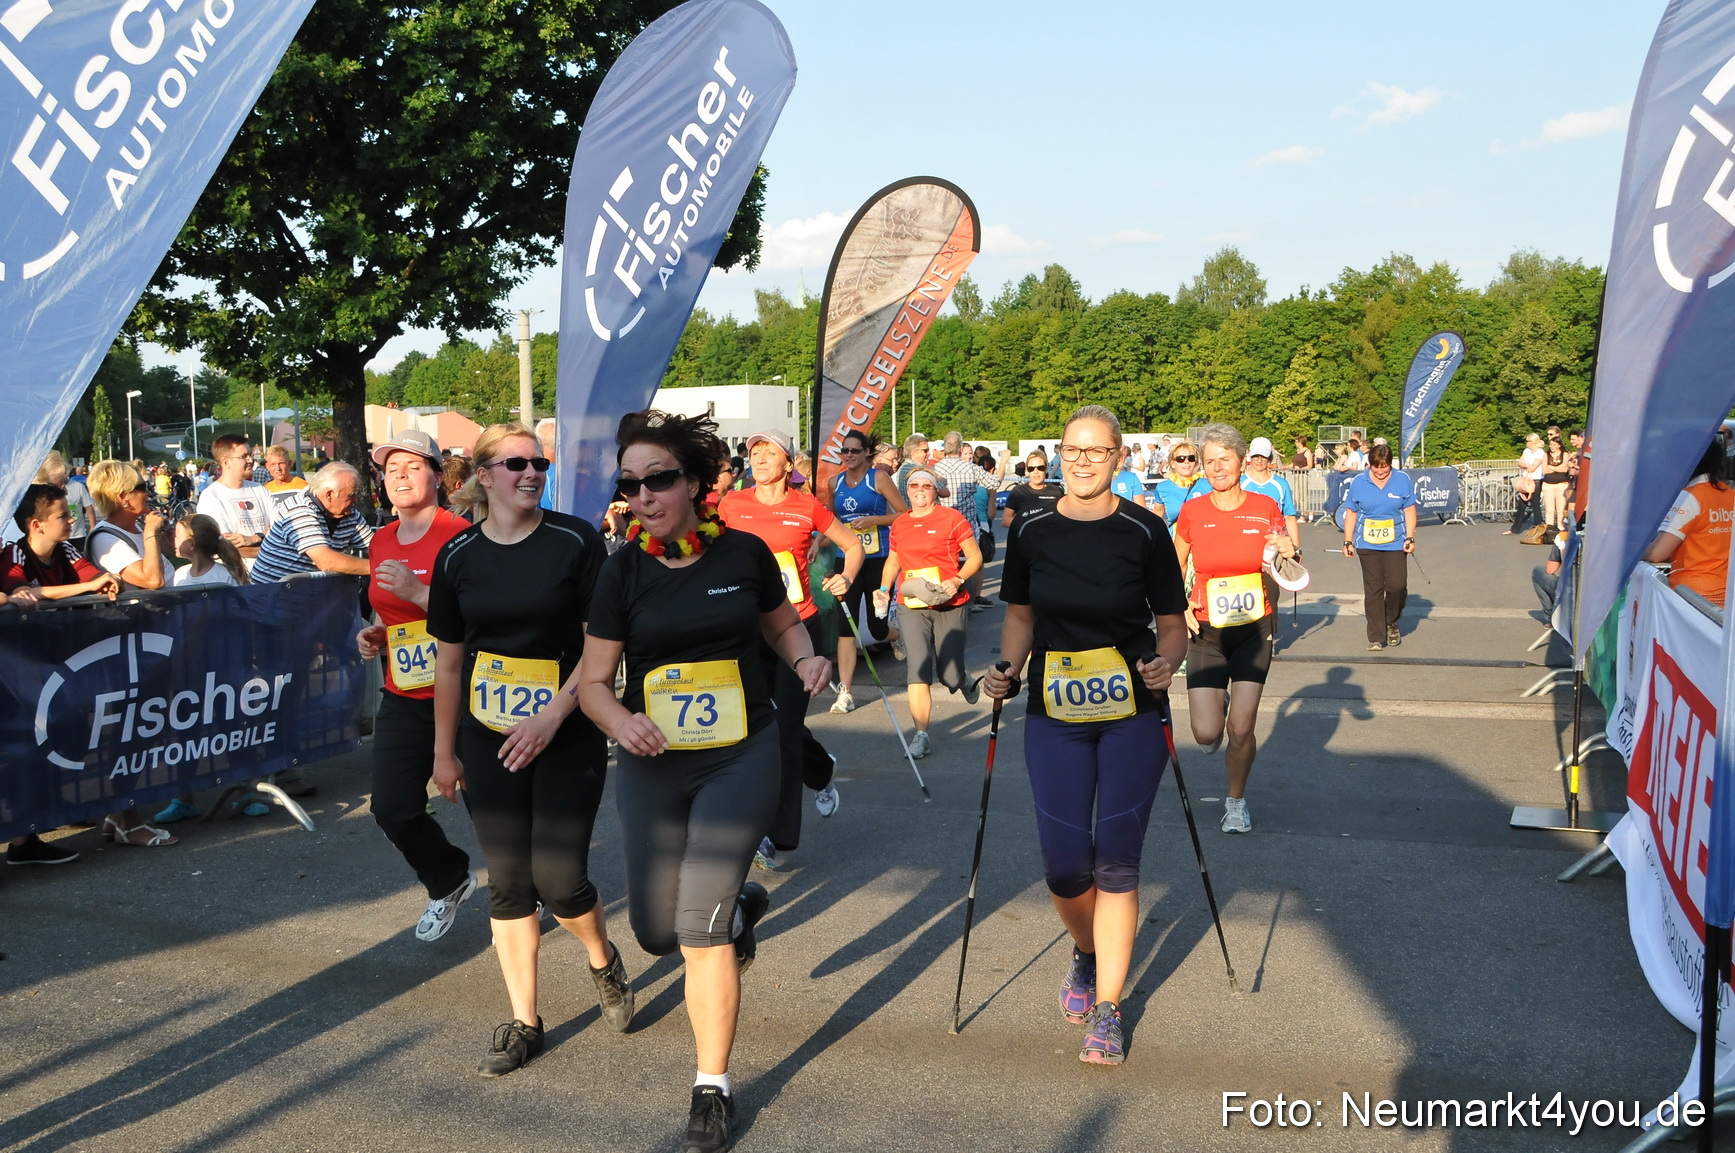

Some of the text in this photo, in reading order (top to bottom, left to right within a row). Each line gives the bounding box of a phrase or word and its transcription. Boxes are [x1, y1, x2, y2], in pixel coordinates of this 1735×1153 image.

[11, 0, 186, 217] Fisc
[105, 0, 236, 211] AUTOMO
[613, 45, 737, 299] Fischer
[657, 85, 755, 292] AUTOMOBILE
[1405, 360, 1447, 418] Frischmann
[1420, 486, 1451, 501] Fischer
[1367, 527, 1390, 538] 478
[1216, 591, 1256, 615] 940
[396, 641, 438, 674] 941
[87, 671, 293, 750] Fischer
[474, 681, 553, 717] 1128
[671, 692, 719, 728] 73
[1047, 674, 1129, 707] 1086
[108, 721, 278, 780] AUTOMOBILE
